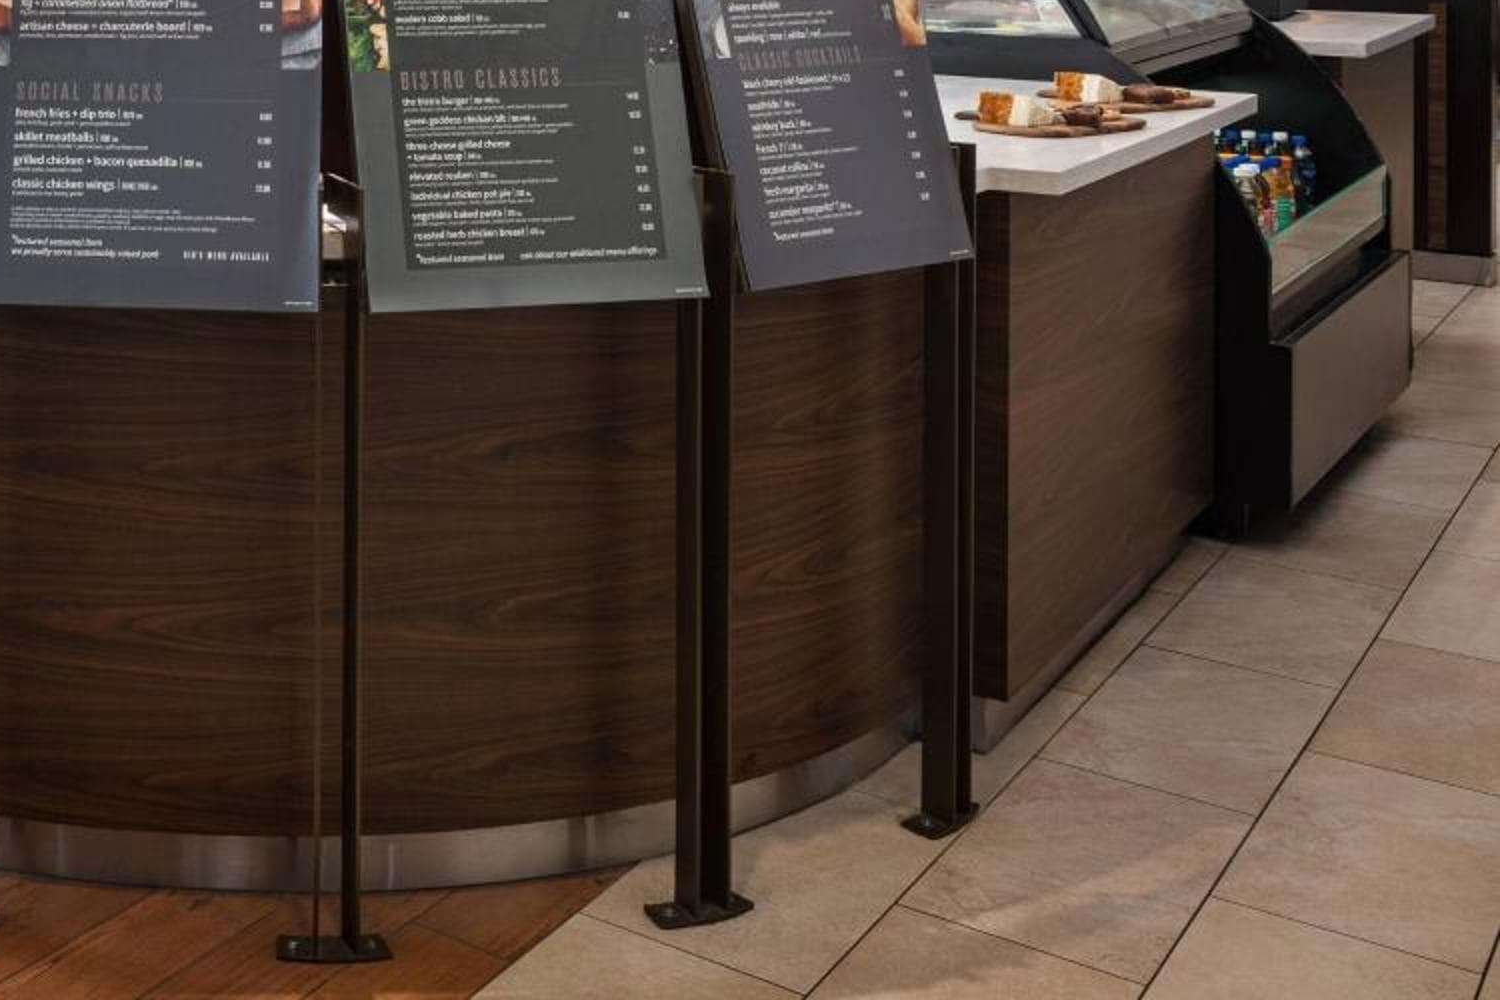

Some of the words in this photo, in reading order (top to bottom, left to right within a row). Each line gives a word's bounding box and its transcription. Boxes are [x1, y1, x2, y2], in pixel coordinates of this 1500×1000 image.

[19, 21, 54, 32] artisan
[55, 21, 89, 32] cheese
[99, 21, 155, 32] charcuterie
[156, 20, 187, 32] board
[400, 70, 464, 91] BISTRO
[475, 66, 562, 89] CLASSICS
[16, 81, 81, 102] SOCIAL
[93, 81, 164, 104] SNACKS
[15, 108, 47, 119] french
[49, 108, 71, 119] fries
[79, 109, 96, 121] dip
[97, 110, 117, 120] trio
[14, 132, 44, 143] skillet
[45, 131, 95, 143] meatballs
[13, 155, 45, 167] grilled
[46, 155, 84, 166] chicken
[93, 156, 125, 167] bacon
[126, 156, 178, 168] quesadilla
[11, 178, 44, 189] classic
[46, 178, 84, 189] chicken
[85, 181, 116, 192] wings
